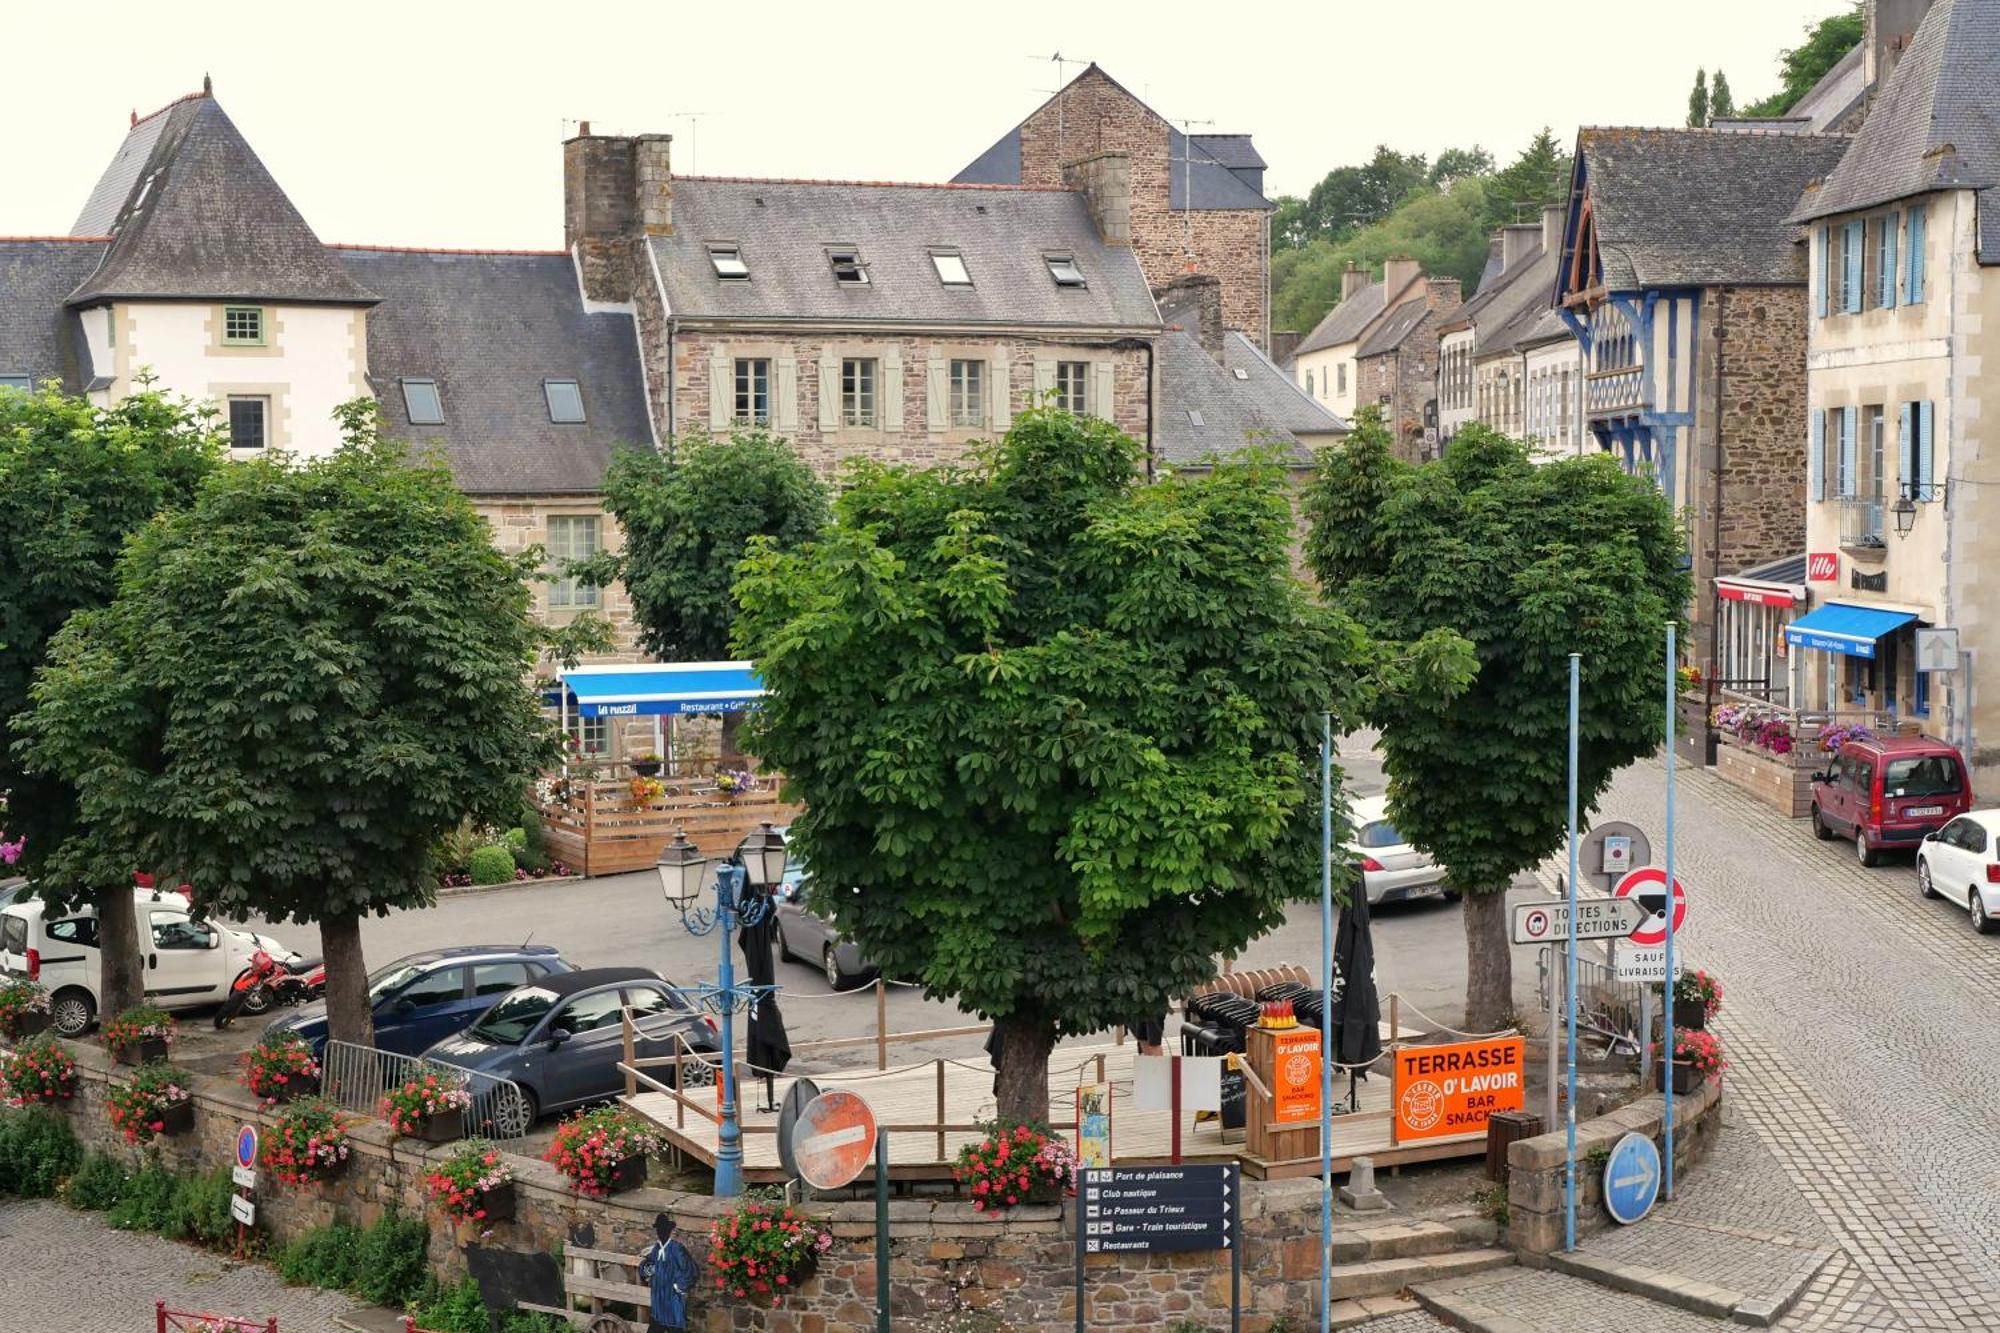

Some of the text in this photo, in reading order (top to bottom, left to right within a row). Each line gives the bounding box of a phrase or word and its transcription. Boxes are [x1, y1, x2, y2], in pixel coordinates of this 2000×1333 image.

[1810, 556, 1835, 579] illy
[680, 702, 723, 712] Restaurant
[1554, 906, 1601, 920] TOTES
[1554, 919, 1628, 935] DIECTIONS
[1634, 952, 1665, 962] SAUF
[1619, 967, 1680, 977] LIVRAISOS
[1404, 1046, 1516, 1076] TERRASSE
[1467, 1095, 1495, 1109] BAR
[1446, 1106, 1516, 1126] SNACK
[1115, 1171, 1184, 1181] Port de plaisance
[1102, 1188, 1157, 1199] Club nautique
[1102, 1204, 1185, 1215] Le Passeur du Trieux
[1115, 1223, 1134, 1232] Gare
[1142, 1222, 1164, 1231] Train
[1165, 1221, 1208, 1232] touristique
[1102, 1240, 1150, 1250] Restaurants
